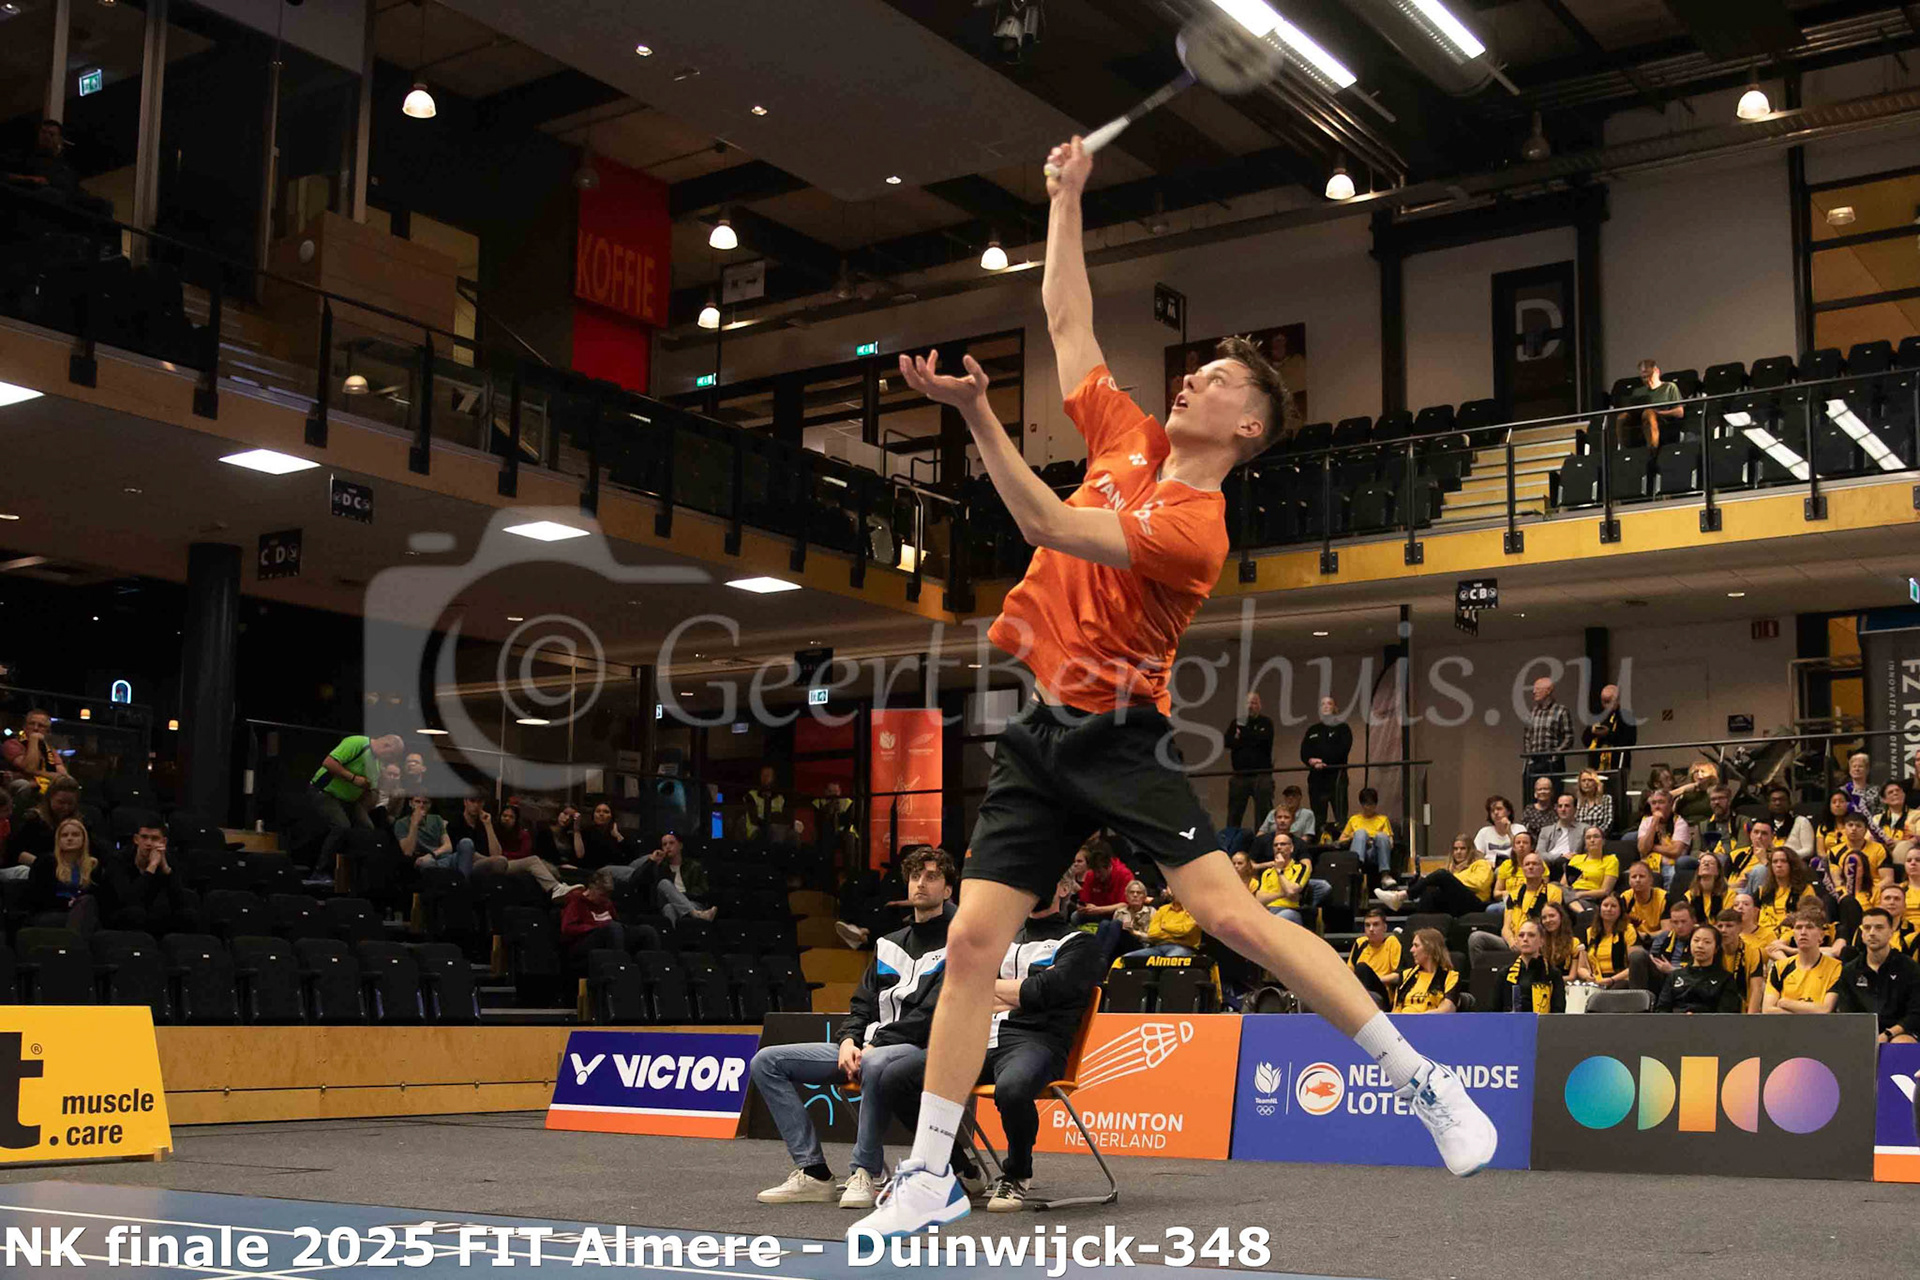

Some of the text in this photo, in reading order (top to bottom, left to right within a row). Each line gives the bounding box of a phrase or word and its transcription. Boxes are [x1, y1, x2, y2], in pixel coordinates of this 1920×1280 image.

[575, 229, 656, 319] KOFFIE
[1469, 588, 1488, 600] C B
[1887, 660, 1897, 716] INNOVATED
[1145, 955, 1192, 967] Almere
[612, 1053, 746, 1092] VICTOR
[61, 1088, 154, 1115] muscle
[1347, 1091, 1418, 1116] LOTE
[1052, 1110, 1184, 1132] BADMINTON
[1065, 1131, 1166, 1149] NEDERLAND
